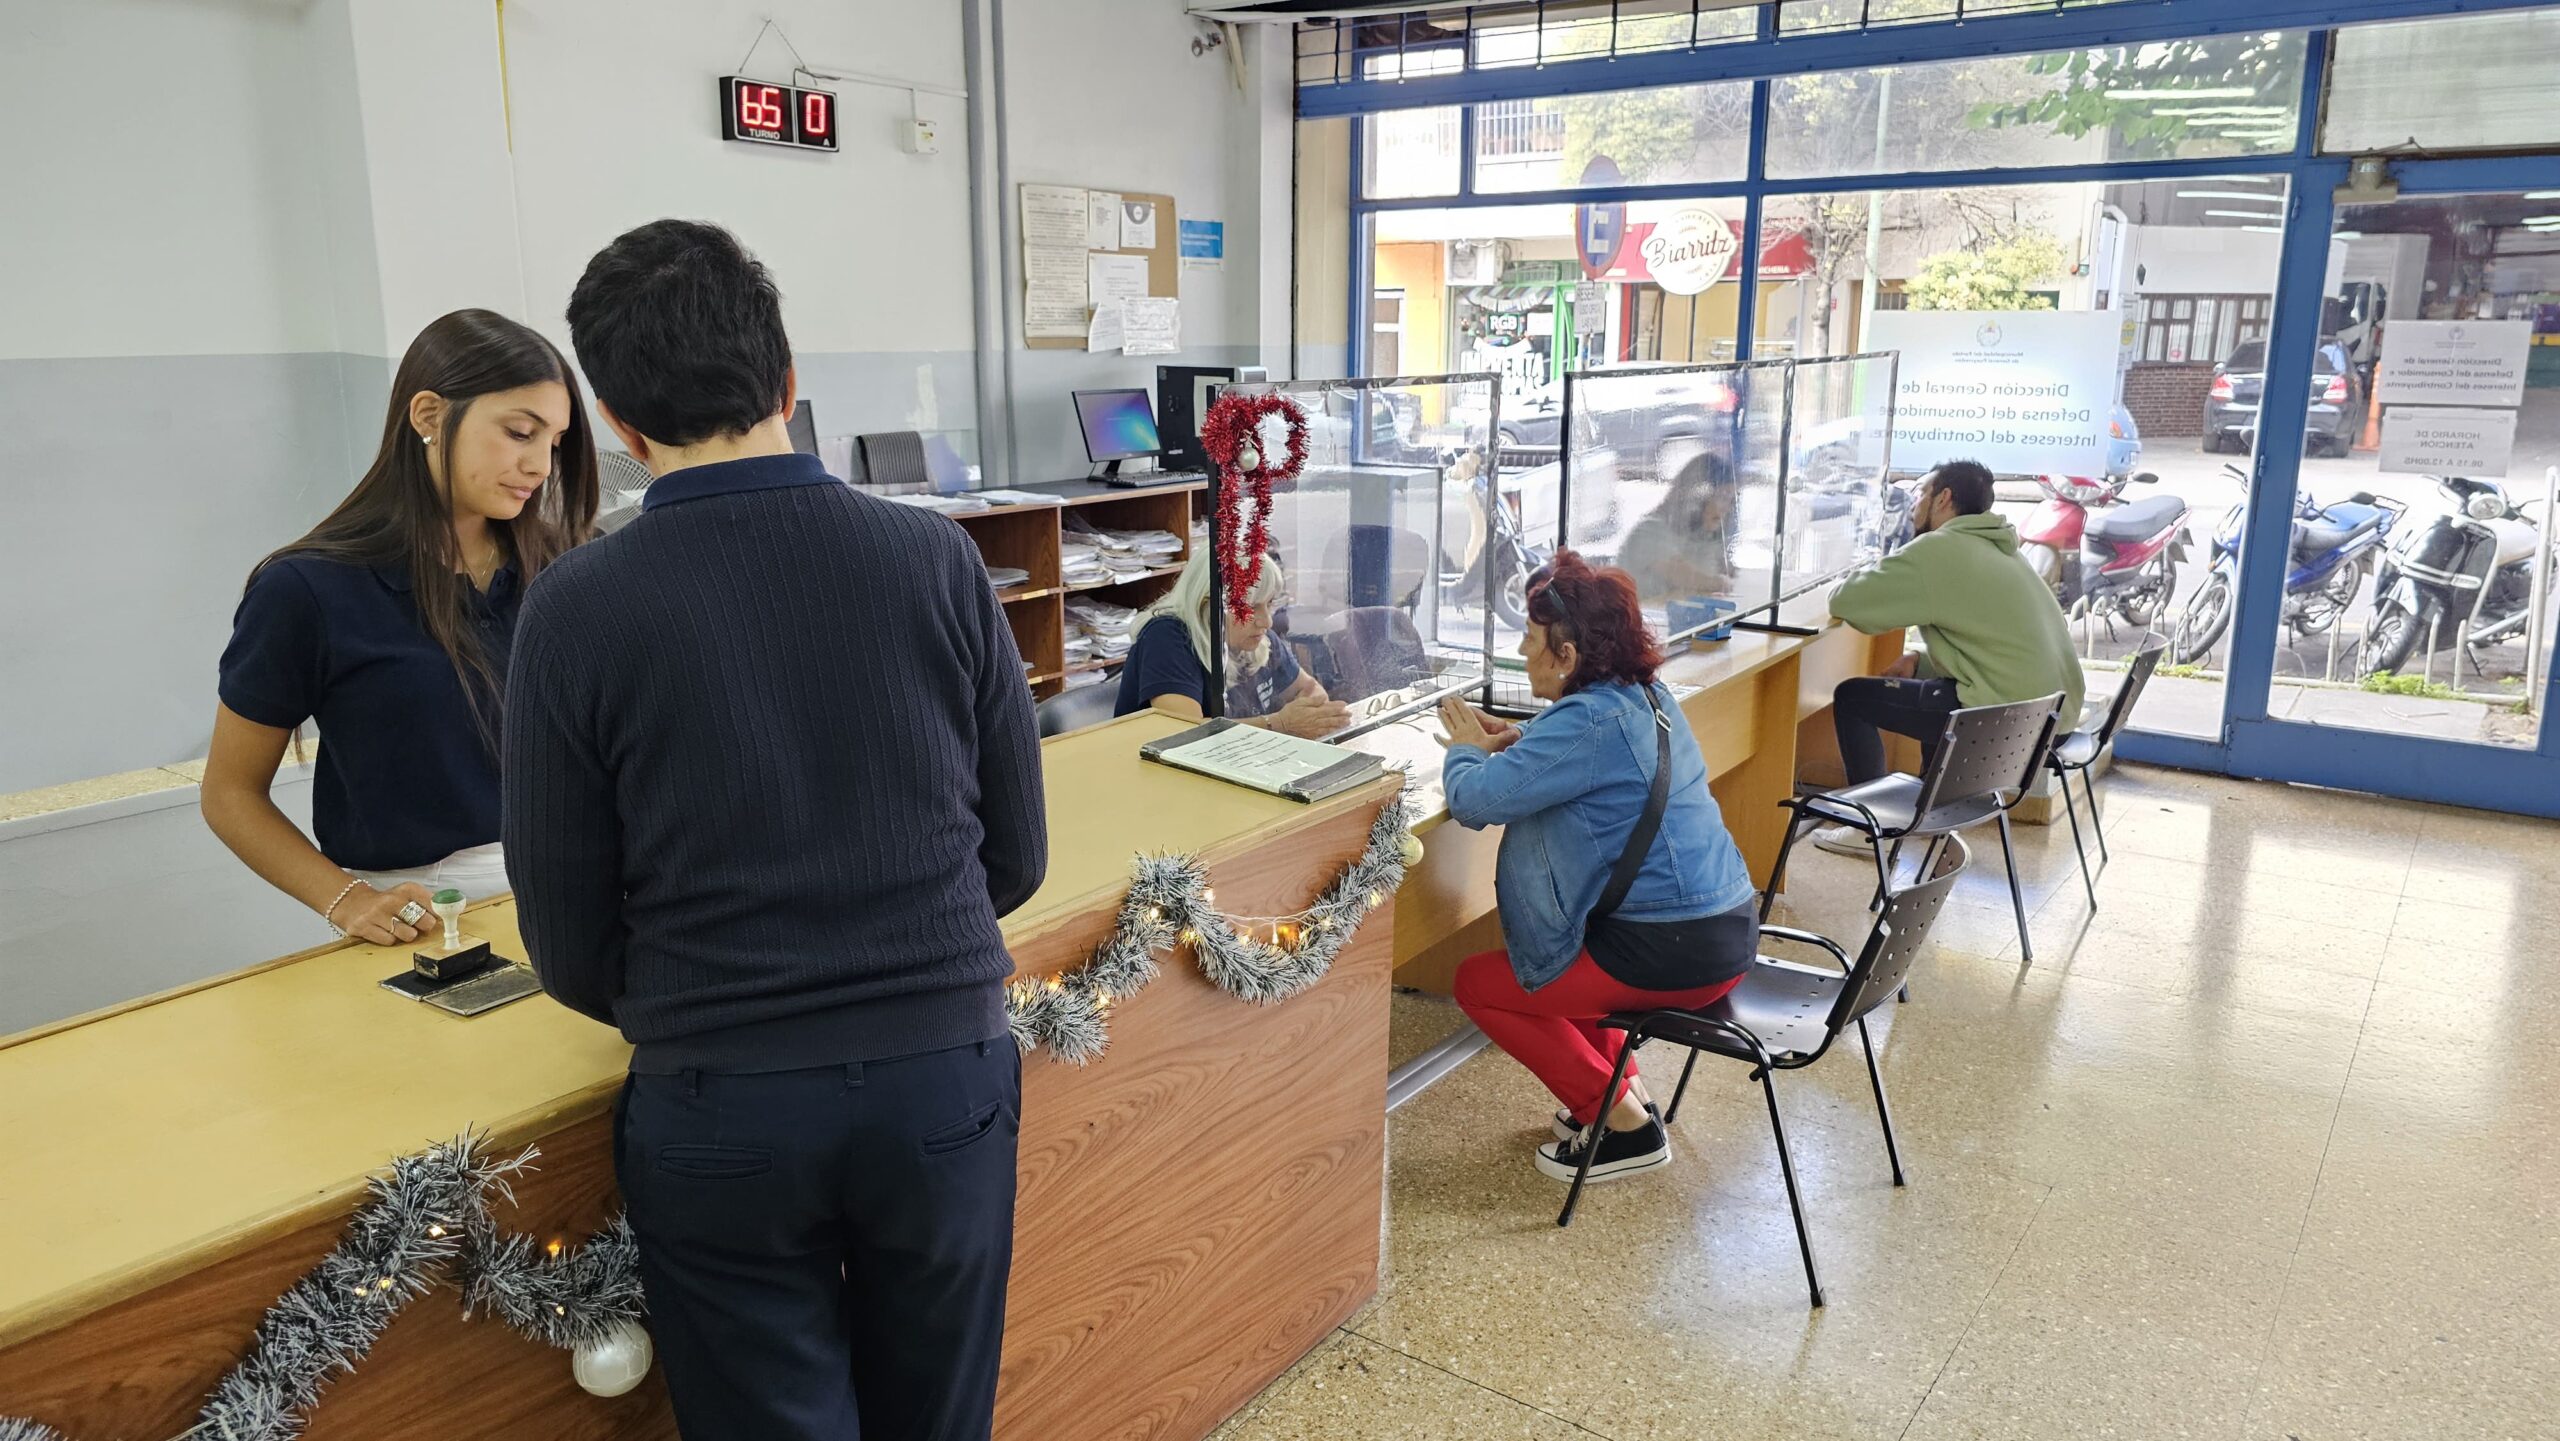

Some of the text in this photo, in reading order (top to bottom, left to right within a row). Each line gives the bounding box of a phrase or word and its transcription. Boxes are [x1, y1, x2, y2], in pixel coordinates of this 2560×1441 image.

[806, 94, 826, 133] 0
[749, 128, 781, 140] TURNO
[1645, 229, 1730, 268] Biarritz
[1490, 316, 1517, 330] RGB
